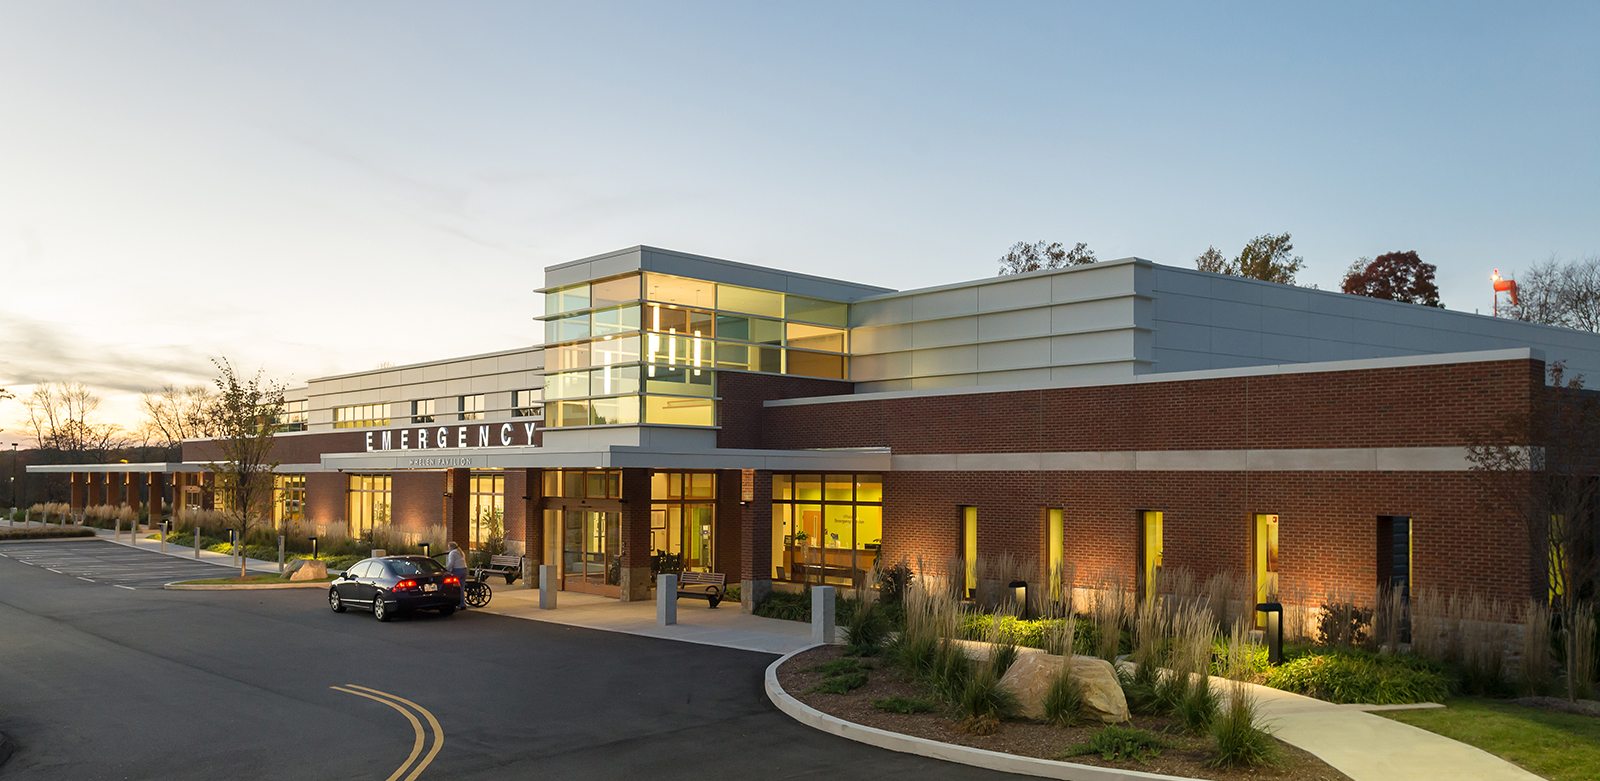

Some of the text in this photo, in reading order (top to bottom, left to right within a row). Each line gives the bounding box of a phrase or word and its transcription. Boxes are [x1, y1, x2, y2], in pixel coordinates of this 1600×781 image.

[366, 422, 537, 451] EMERGENCY
[409, 457, 472, 466] WHELEN PAVILION
